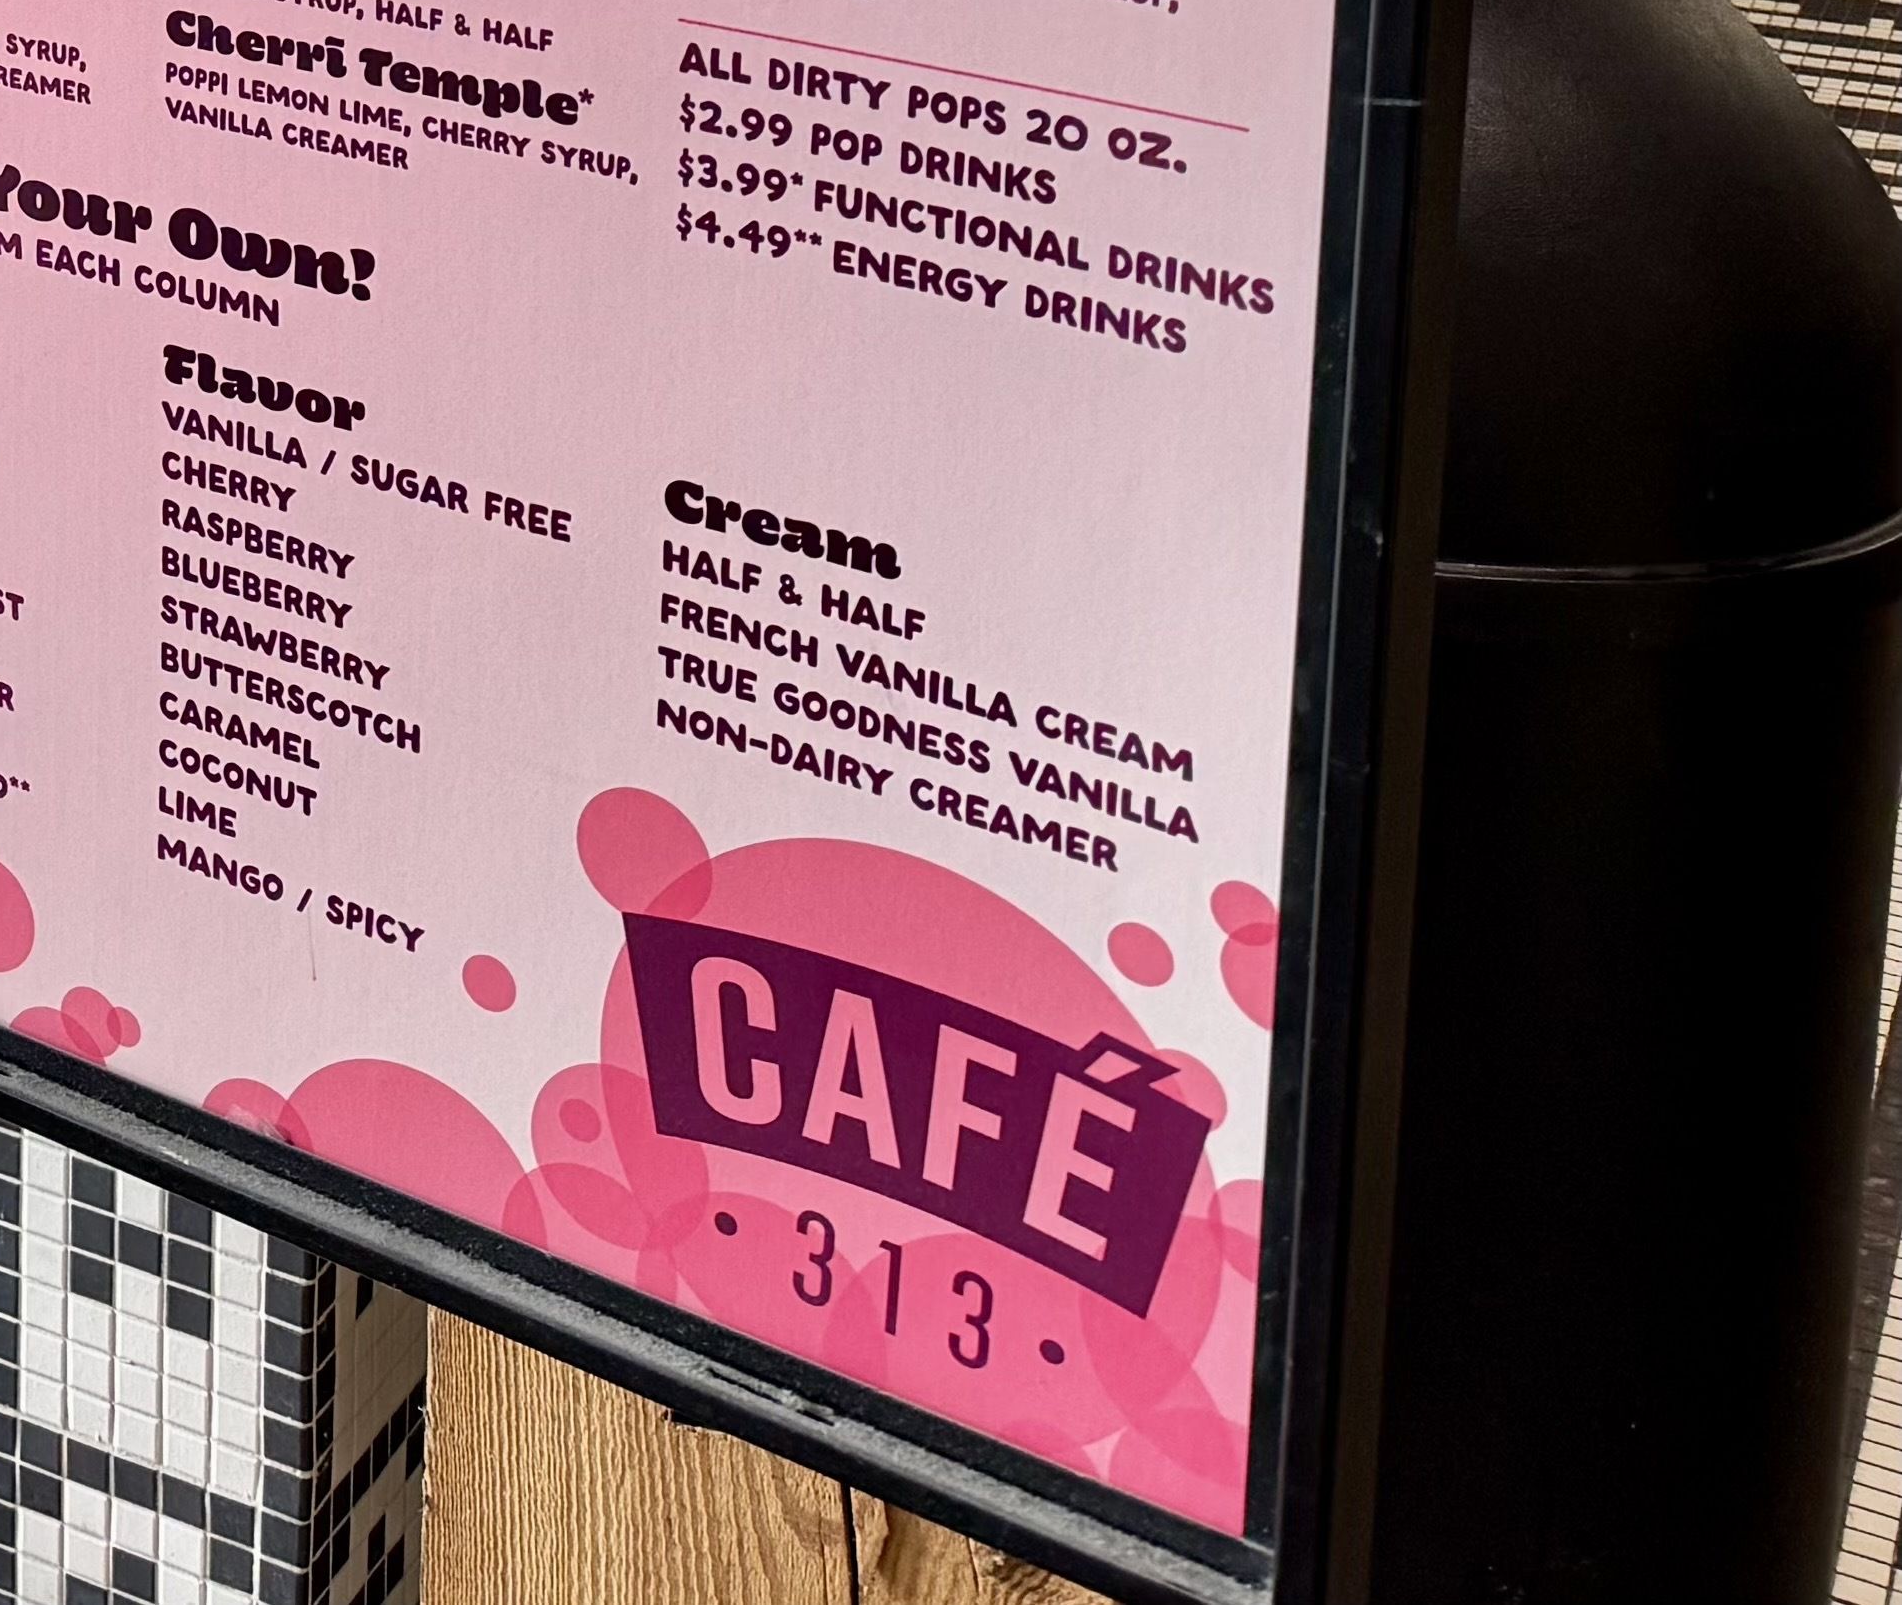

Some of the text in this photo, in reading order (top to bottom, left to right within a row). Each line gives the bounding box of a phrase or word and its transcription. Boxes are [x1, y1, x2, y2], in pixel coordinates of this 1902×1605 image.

[165, 9, 348, 79] Cherri
[678, 42, 1187, 174] ALL DIRTY POPS 20 OZ.
[679, 92, 1057, 205] $2.99 POP DRINKS
[36, 238, 121, 287] EACH
[134, 264, 280, 327] COLUMN
[167, 207, 376, 302] Own!
[814, 179, 1090, 272] FUNCTIONAL
[1108, 244, 1275, 315] DRINKS
[832, 240, 1009, 309] ENERGY
[1024, 284, 1187, 354] DRINKS
[162, 344, 366, 432] Flavor
[161, 450, 297, 513] CHERRY
[664, 479, 902, 580] Cream
[161, 498, 356, 580] RASPBERRY
[161, 545, 353, 629] BLUEBERRY
[160, 594, 391, 691] STRAWBERRY
[159, 691, 321, 770] CARAMEL
[160, 641, 421, 754] BUTTERSCOTCH
[657, 645, 1199, 844] TRUE GOODNESS VANILLA
[158, 738, 318, 817] COCONUT
[158, 785, 237, 839] LIME
[689, 955, 1143, 1263] CAFÉ
[792, 1209, 994, 1370] 313
